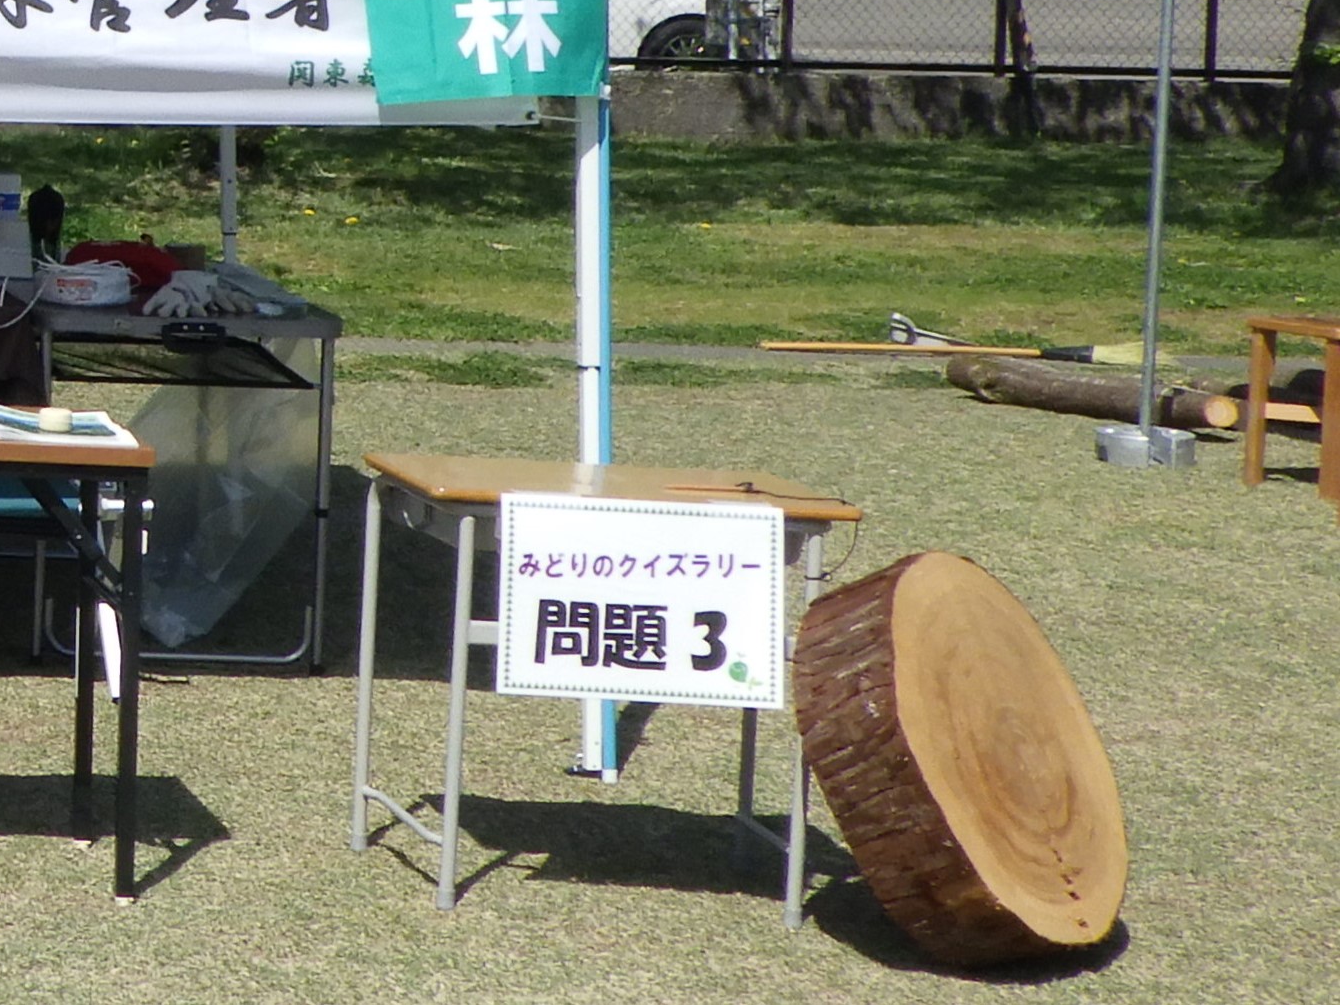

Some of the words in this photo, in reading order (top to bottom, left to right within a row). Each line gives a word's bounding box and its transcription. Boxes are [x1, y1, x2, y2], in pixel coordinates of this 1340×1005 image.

[518, 552, 761, 579] みどりのクイズラリー
